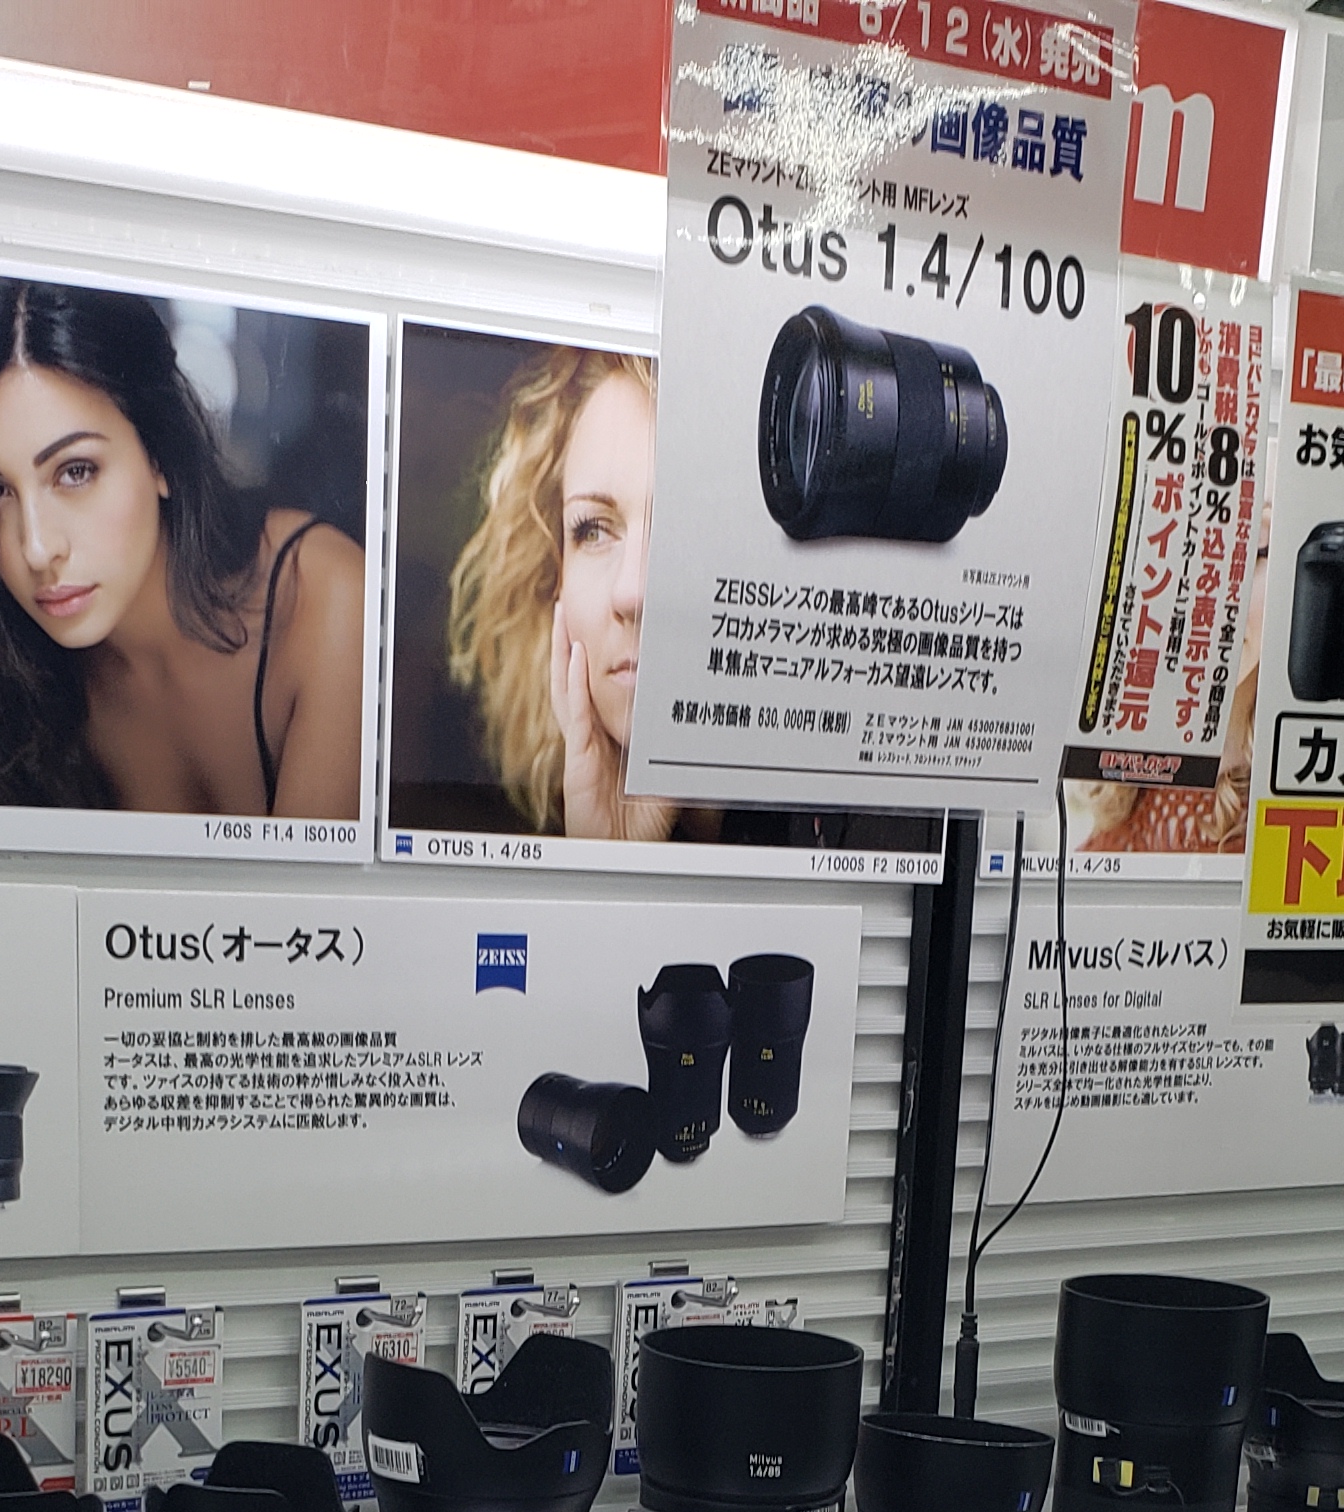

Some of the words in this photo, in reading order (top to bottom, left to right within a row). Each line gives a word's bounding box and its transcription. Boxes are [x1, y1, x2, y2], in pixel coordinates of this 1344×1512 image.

[707, 195, 848, 282] Otus
[878, 223, 1085, 320] 1.4/100
[672, 701, 751, 727] 希望小売価格
[946, 716, 964, 731] JAN
[943, 735, 960, 749] JAN
[204, 822, 252, 842] 1/60S
[262, 824, 294, 843] F1.4
[304, 825, 357, 844] ISO100
[428, 839, 474, 858] OTUS
[810, 855, 864, 874] 1/1000S
[873, 858, 888, 874] F2
[895, 858, 938, 875] ISO100
[477, 949, 526, 967] ZEISS
[1028, 938, 1229, 971] Mivus(ミルバス)
[104, 988, 182, 1009] Premium
[190, 989, 225, 1009] SLR
[233, 990, 295, 1010] Lenses
[1024, 990, 1049, 1010] SLR
[1102, 990, 1120, 1008] for
[1124, 990, 1162, 1009] Digital
[313, 1323, 342, 1450] EXUS
[103, 1338, 134, 1473] EXUS
[749, 1453, 783, 1466] Milvus
